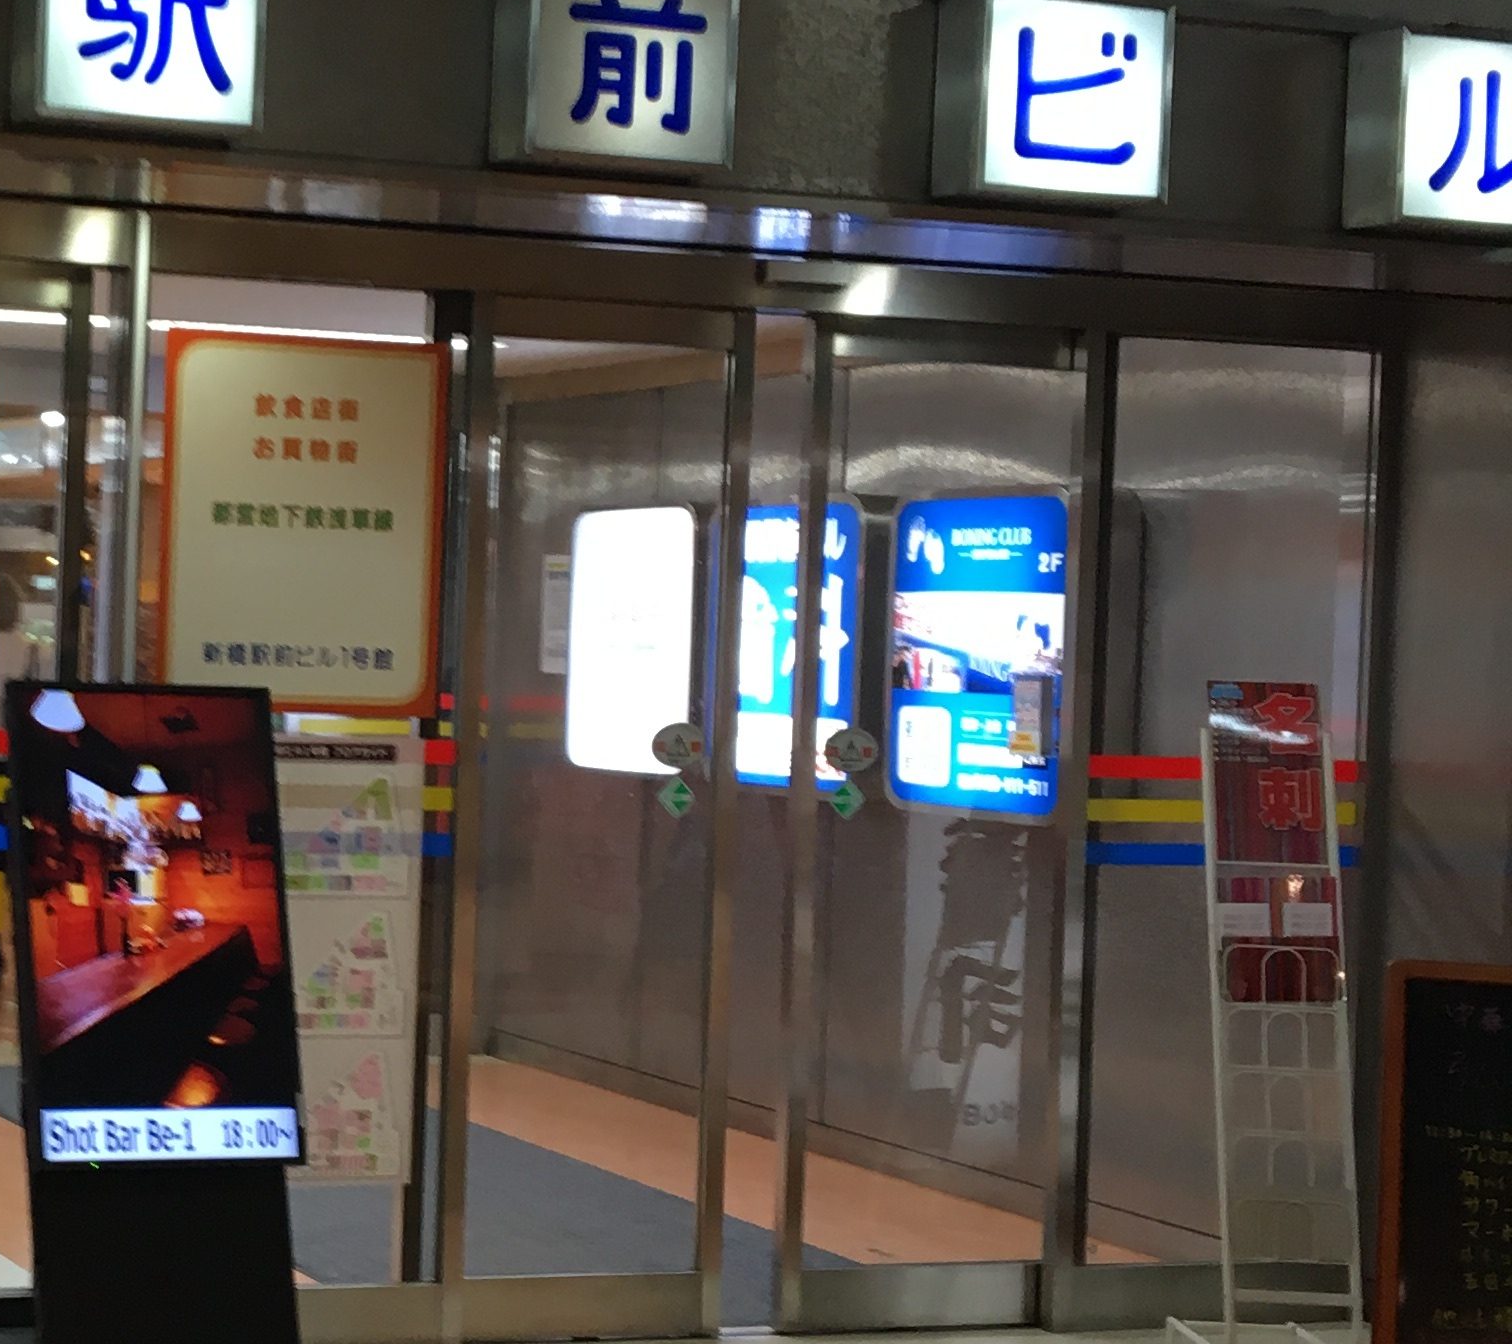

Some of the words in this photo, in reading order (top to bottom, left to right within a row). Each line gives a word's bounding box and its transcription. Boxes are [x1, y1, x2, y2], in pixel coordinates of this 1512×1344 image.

[212, 502, 394, 531] 都営地下鉄浅草線
[1038, 552, 1065, 573] 2F
[203, 642, 395, 671] 新橋駅前ビル1号館
[1254, 692, 1325, 832] 名刺
[49, 1117, 101, 1154] Shot
[103, 1118, 141, 1153] Bar
[145, 1117, 197, 1153] Be-1
